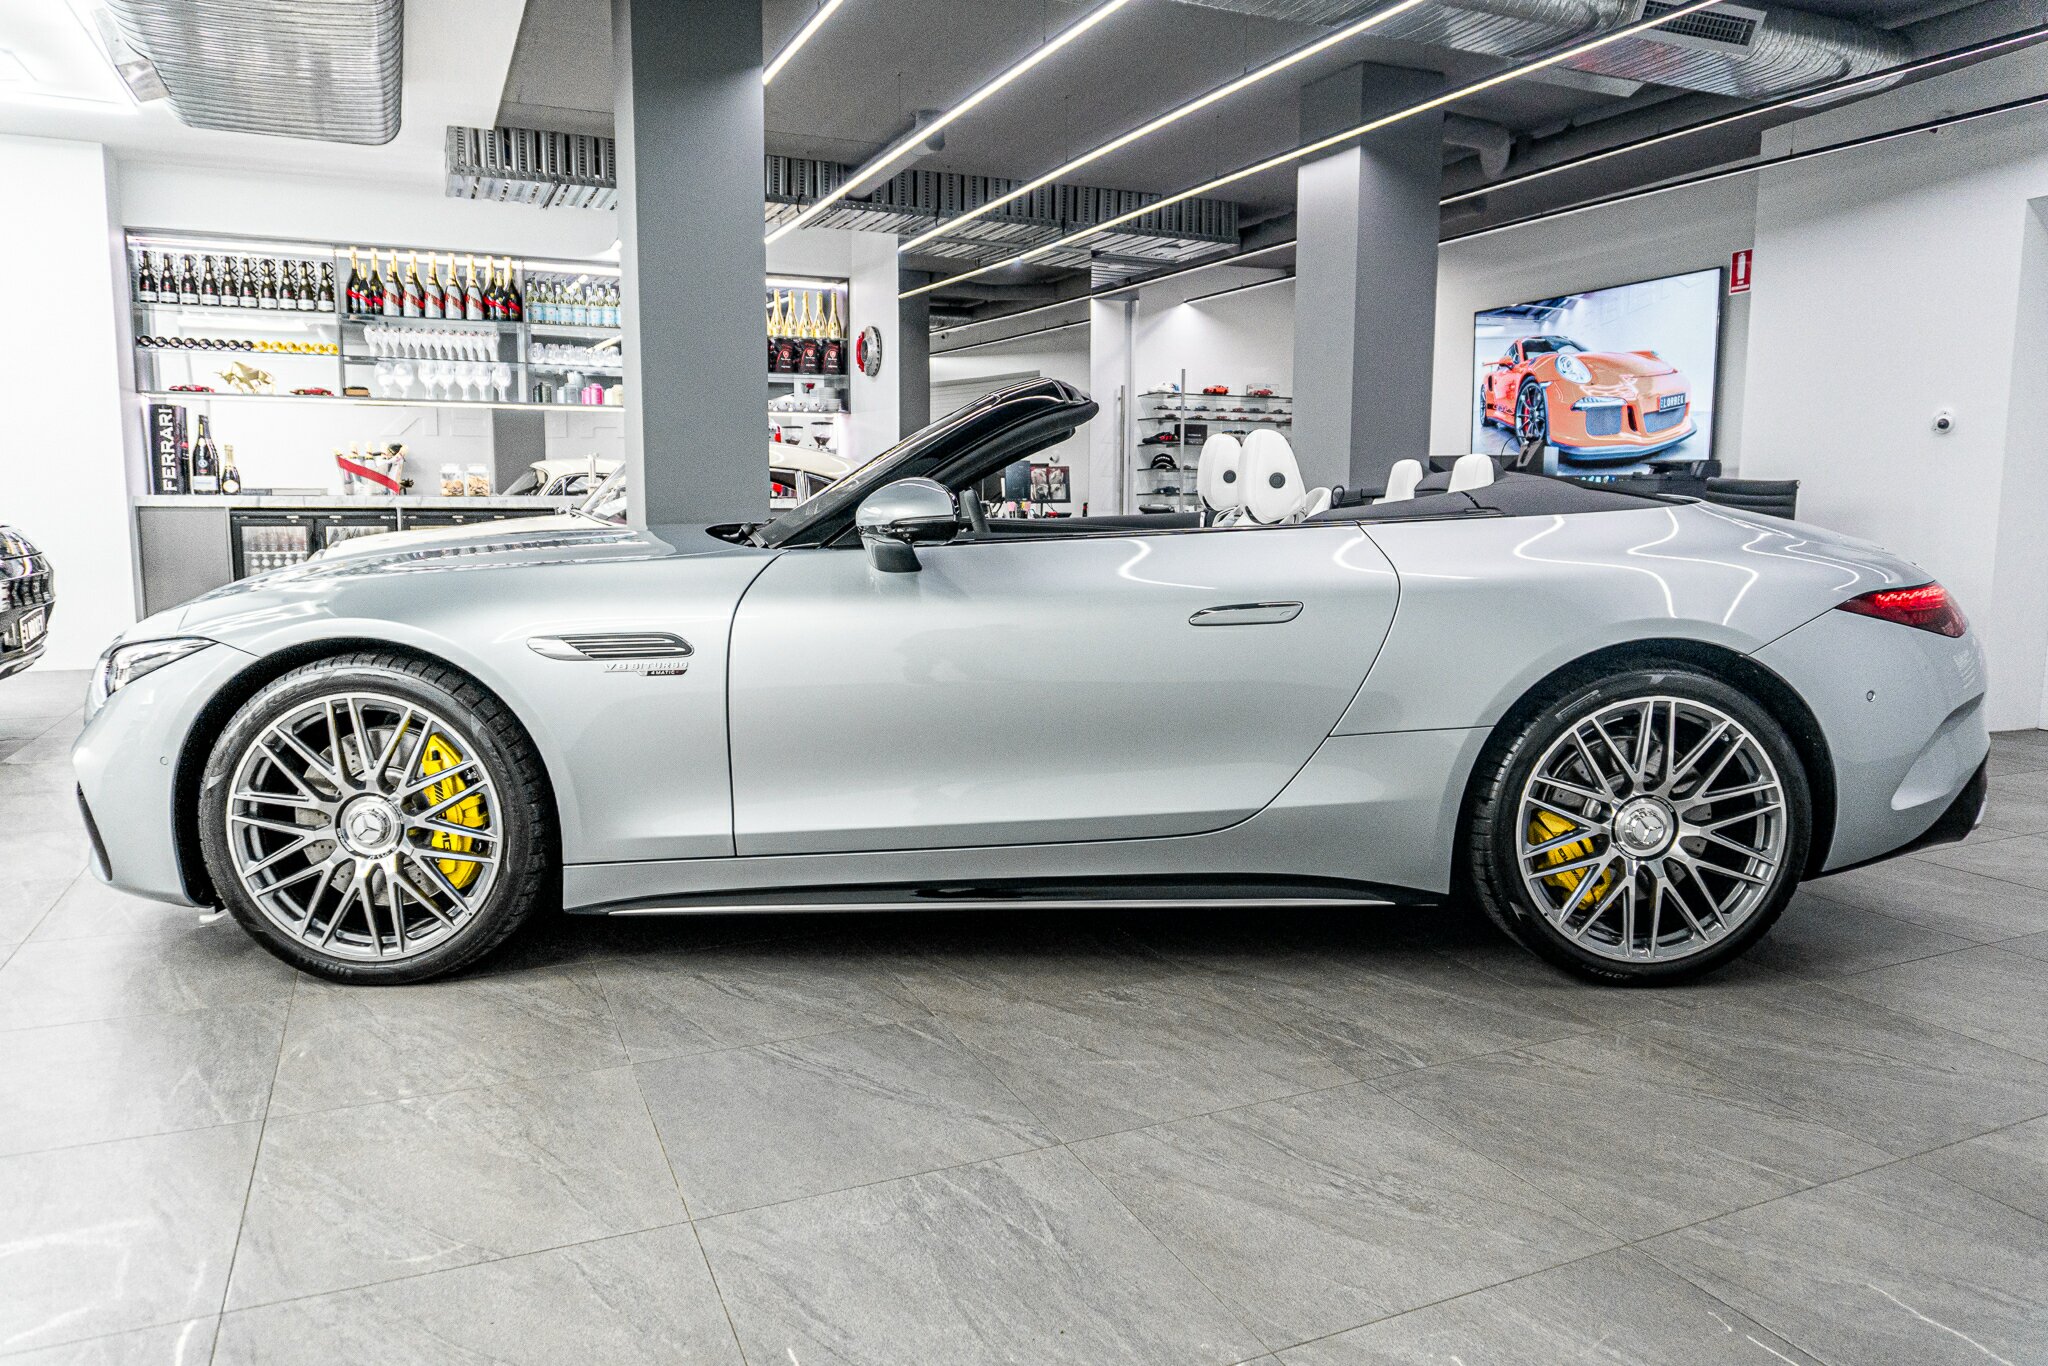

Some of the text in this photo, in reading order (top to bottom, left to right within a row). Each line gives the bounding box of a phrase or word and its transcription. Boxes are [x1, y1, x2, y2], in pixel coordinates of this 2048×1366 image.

[1663, 395, 1685, 408] LORBEK
[158, 408, 178, 492] FERRARI
[604, 662, 689, 671] V8 BITURBO
